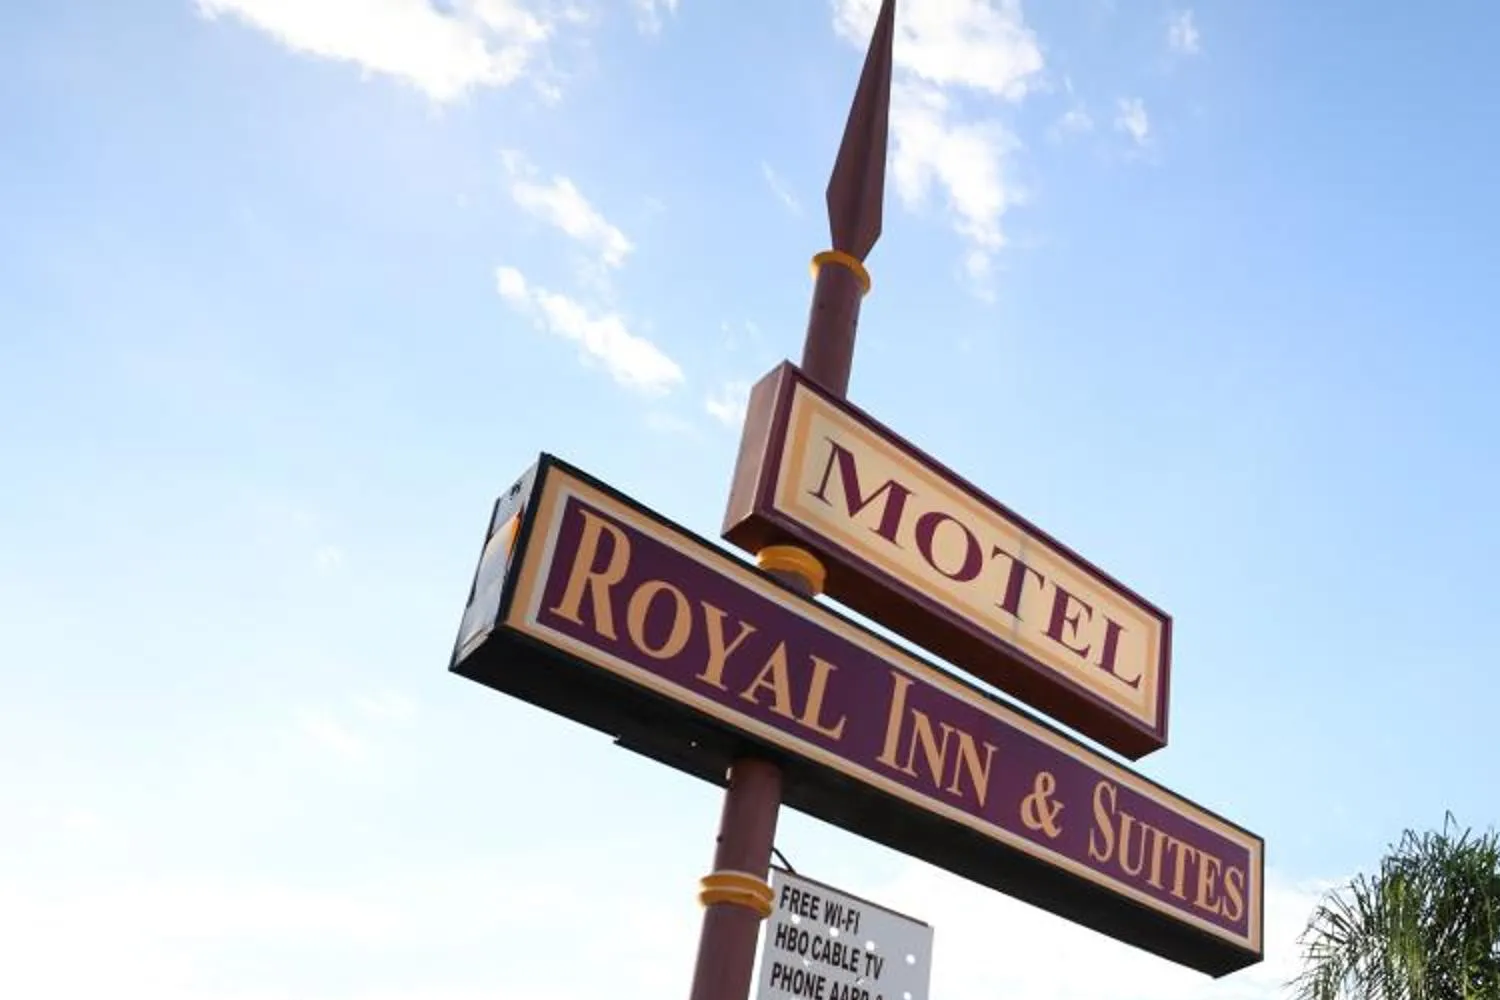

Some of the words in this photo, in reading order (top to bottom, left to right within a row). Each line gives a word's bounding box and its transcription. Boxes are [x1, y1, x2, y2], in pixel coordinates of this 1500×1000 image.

[806, 437, 1142, 689] MOTEL
[550, 508, 847, 740] ROYAL
[876, 671, 998, 808] INN
[1020, 771, 1064, 838] &
[1088, 780, 1245, 921] SUITES
[774, 923, 809, 956] HBO
[811, 935, 861, 973] CABLE
[865, 951, 885, 980] TV
[779, 885, 821, 920] FREE
[824, 900, 861, 935] WI-FI
